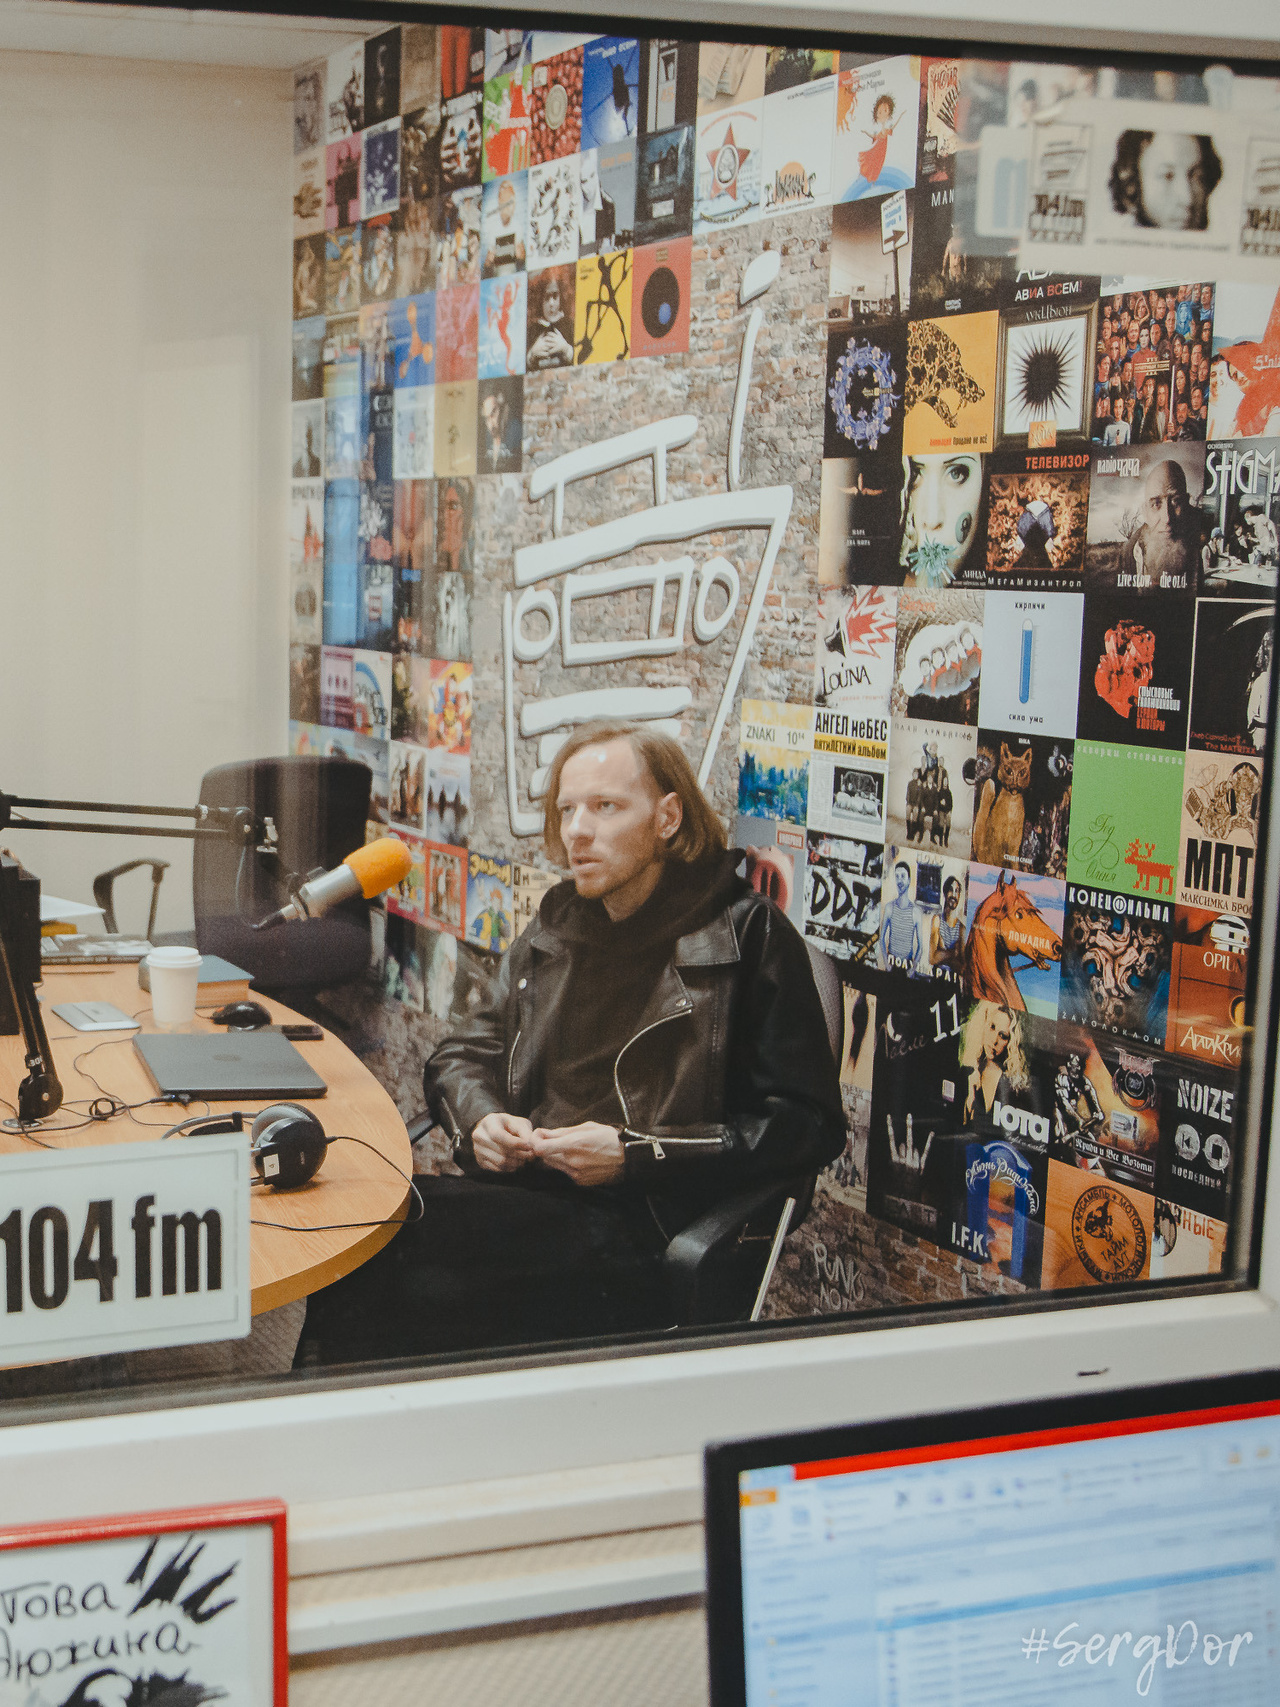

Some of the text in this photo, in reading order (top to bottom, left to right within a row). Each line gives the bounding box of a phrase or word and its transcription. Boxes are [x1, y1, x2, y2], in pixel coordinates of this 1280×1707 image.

[1025, 454, 1090, 471] ТЕЛЕВИЗОР
[746, 724, 776, 743] ZNAKI
[815, 712, 849, 737] АНГЕЛ
[1183, 837, 1255, 899] МПТ
[1181, 892, 1229, 911] МАКСИМКА
[930, 993, 962, 1043] 11
[1177, 1078, 1235, 1124] NOIZE
[131, 1194, 223, 1298] fm
